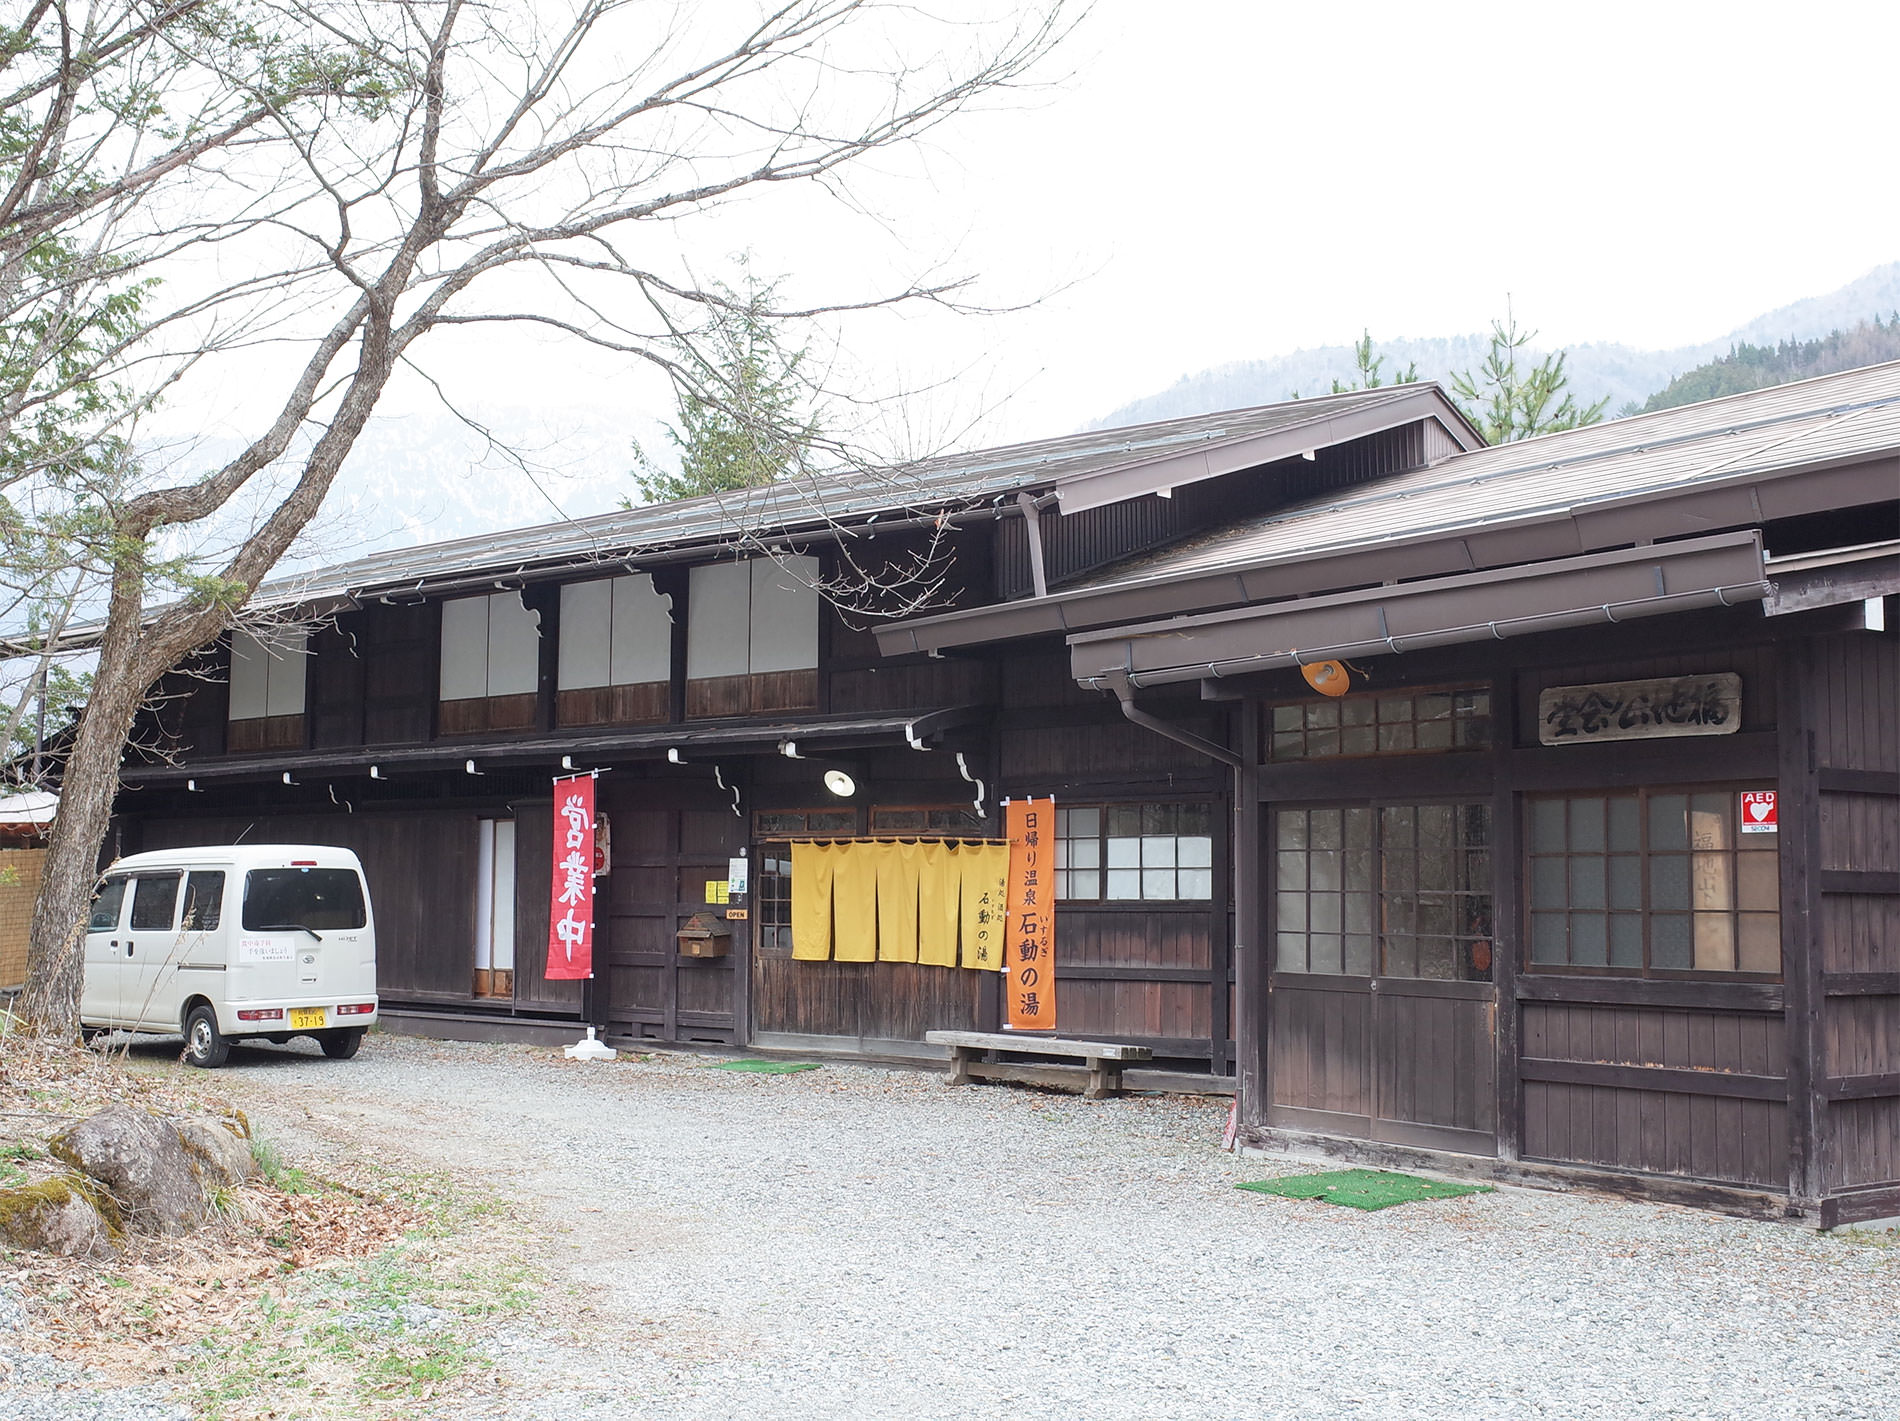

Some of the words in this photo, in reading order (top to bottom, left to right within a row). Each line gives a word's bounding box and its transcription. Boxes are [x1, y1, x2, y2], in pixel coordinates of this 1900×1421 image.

[1744, 792, 1775, 803] AED
[556, 793, 589, 962] 営業中
[1022, 812, 1038, 905] 日帰り温泉
[977, 892, 991, 962] 石動の湯
[1039, 915, 1049, 958] いするぎ
[1019, 912, 1041, 1017] 石動の湯
[298, 1015, 325, 1027] 37-19
